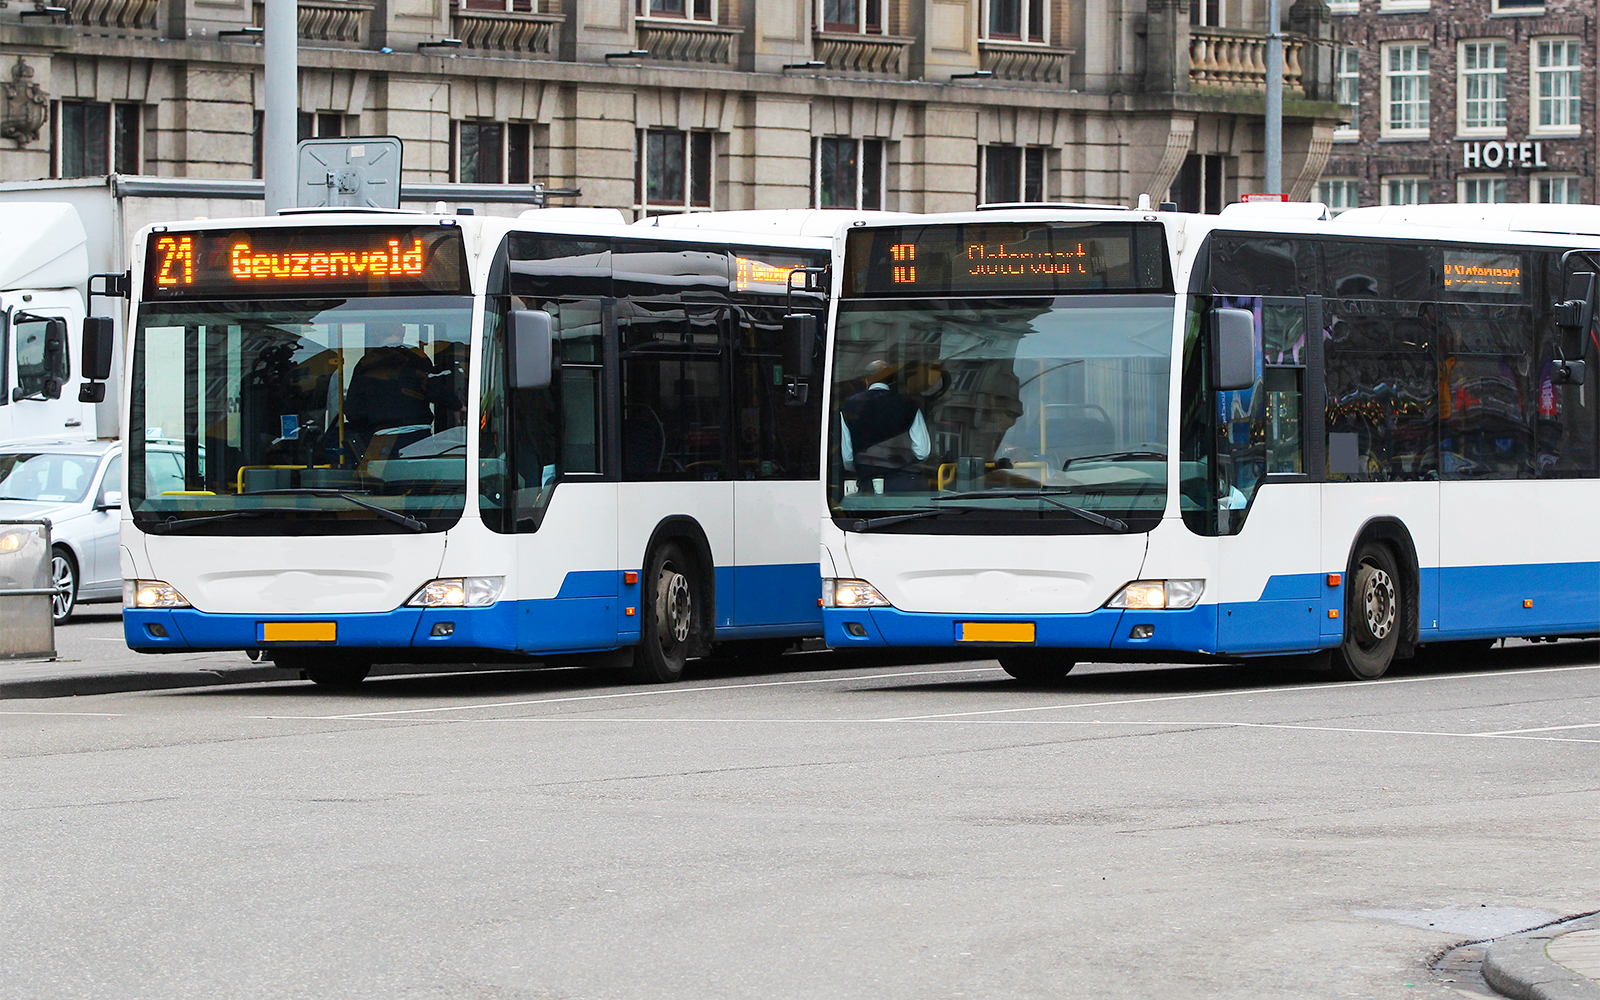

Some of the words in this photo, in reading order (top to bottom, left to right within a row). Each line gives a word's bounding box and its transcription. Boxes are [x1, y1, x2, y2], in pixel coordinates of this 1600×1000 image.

[1463, 141, 1547, 168] HOTEL
[157, 236, 192, 284] 21
[231, 239, 423, 279] Geuzenveld
